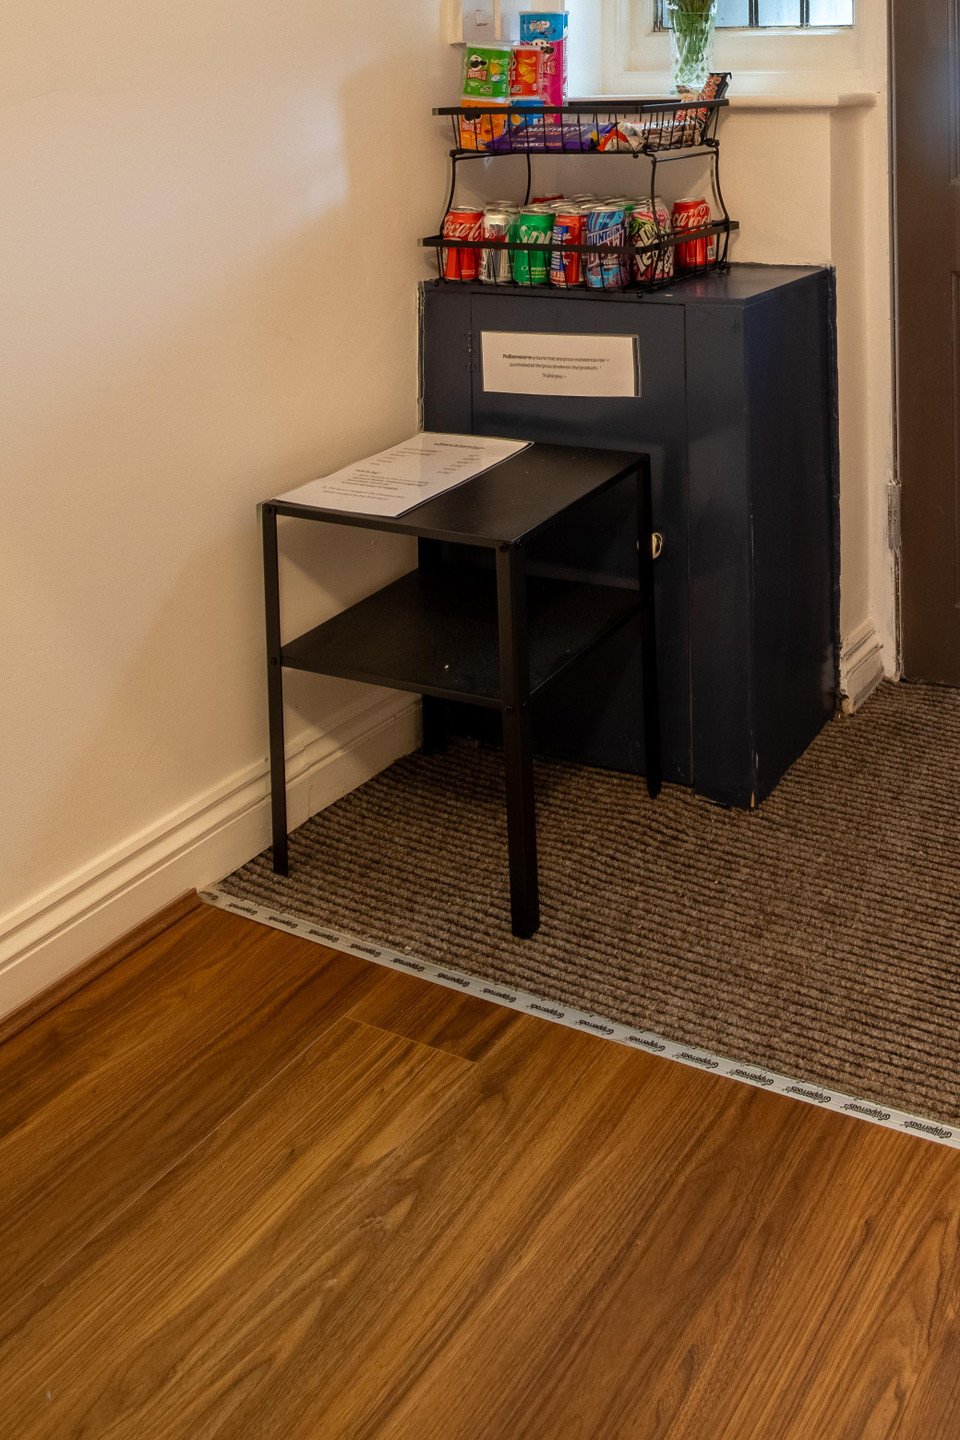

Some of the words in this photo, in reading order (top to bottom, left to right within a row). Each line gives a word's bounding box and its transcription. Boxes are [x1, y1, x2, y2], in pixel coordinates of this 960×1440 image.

[628, 1035, 665, 1052] Gripperrods
[680, 1052, 718, 1069] Gripperrods
[734, 1068, 774, 1086] Gripperrods
[788, 1085, 831, 1103] Gripperrods
[845, 1103, 891, 1121] Gripperrods
[904, 1120, 952, 1139] Gripperrods
